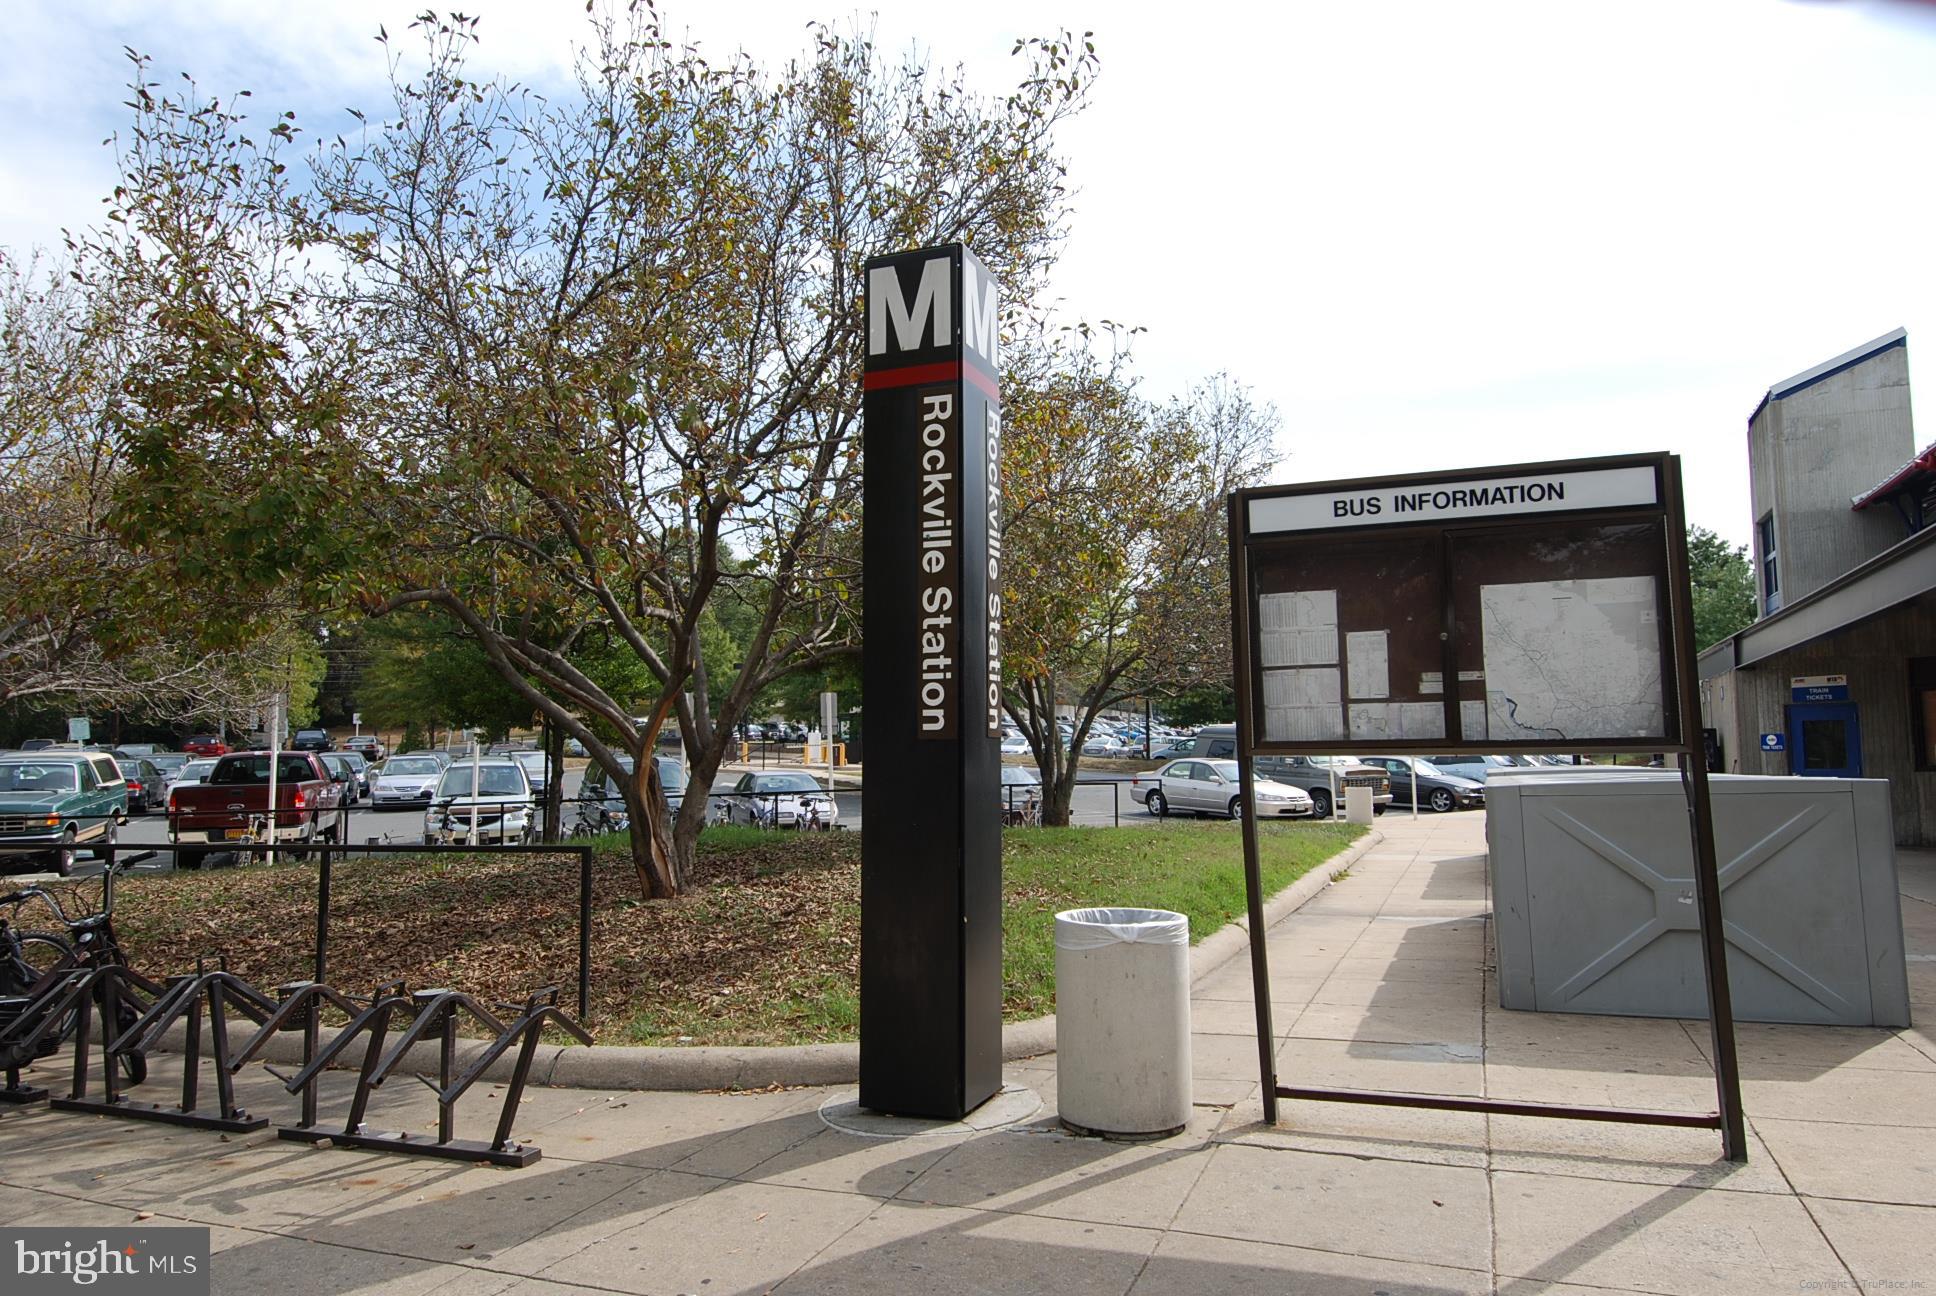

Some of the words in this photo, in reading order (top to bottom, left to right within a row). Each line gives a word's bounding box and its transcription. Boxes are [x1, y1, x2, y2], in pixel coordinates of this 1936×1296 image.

[869, 256, 951, 355] M
[965, 257, 999, 369] M
[922, 394, 952, 573] Rockville
[988, 409, 1001, 580] Rockville
[1333, 497, 1382, 517] BUS
[1394, 482, 1565, 513] INFORMATION
[922, 586, 952, 731] Station
[988, 592, 1001, 730] Station
